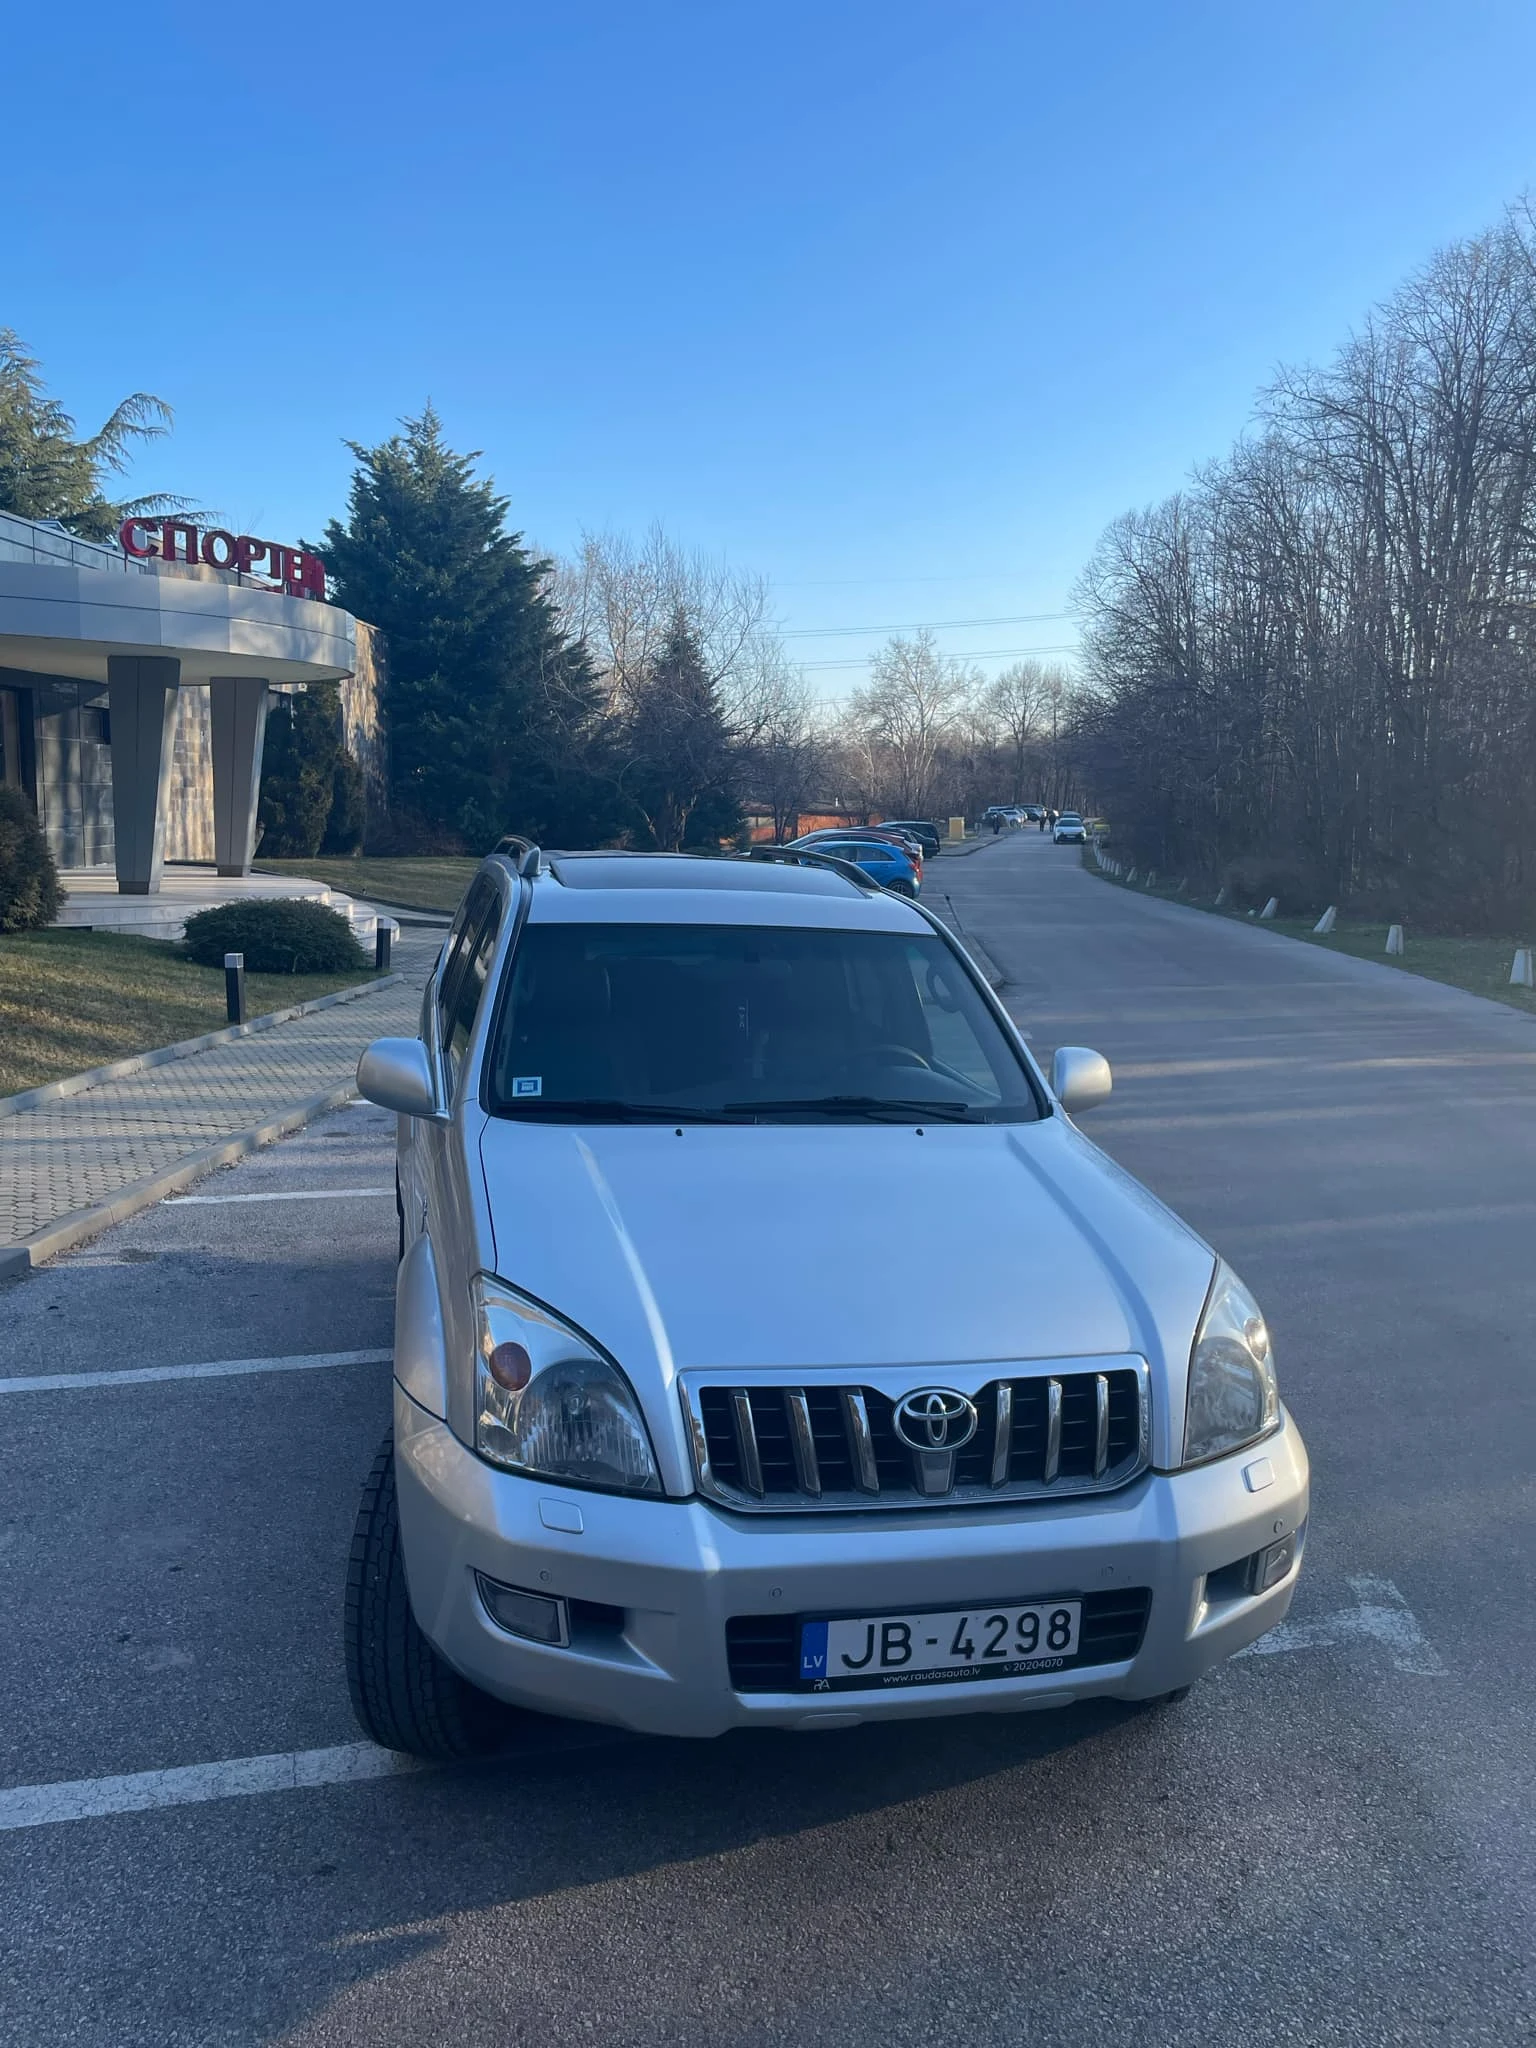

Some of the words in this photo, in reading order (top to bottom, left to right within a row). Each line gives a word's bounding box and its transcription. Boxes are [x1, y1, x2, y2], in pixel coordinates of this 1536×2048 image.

[841, 1608, 1072, 1669] JB-4298
[803, 1655, 824, 1669] LV
[882, 1665, 982, 1684] www.raudasauto.lv
[1012, 1657, 1064, 1672] 20204070
